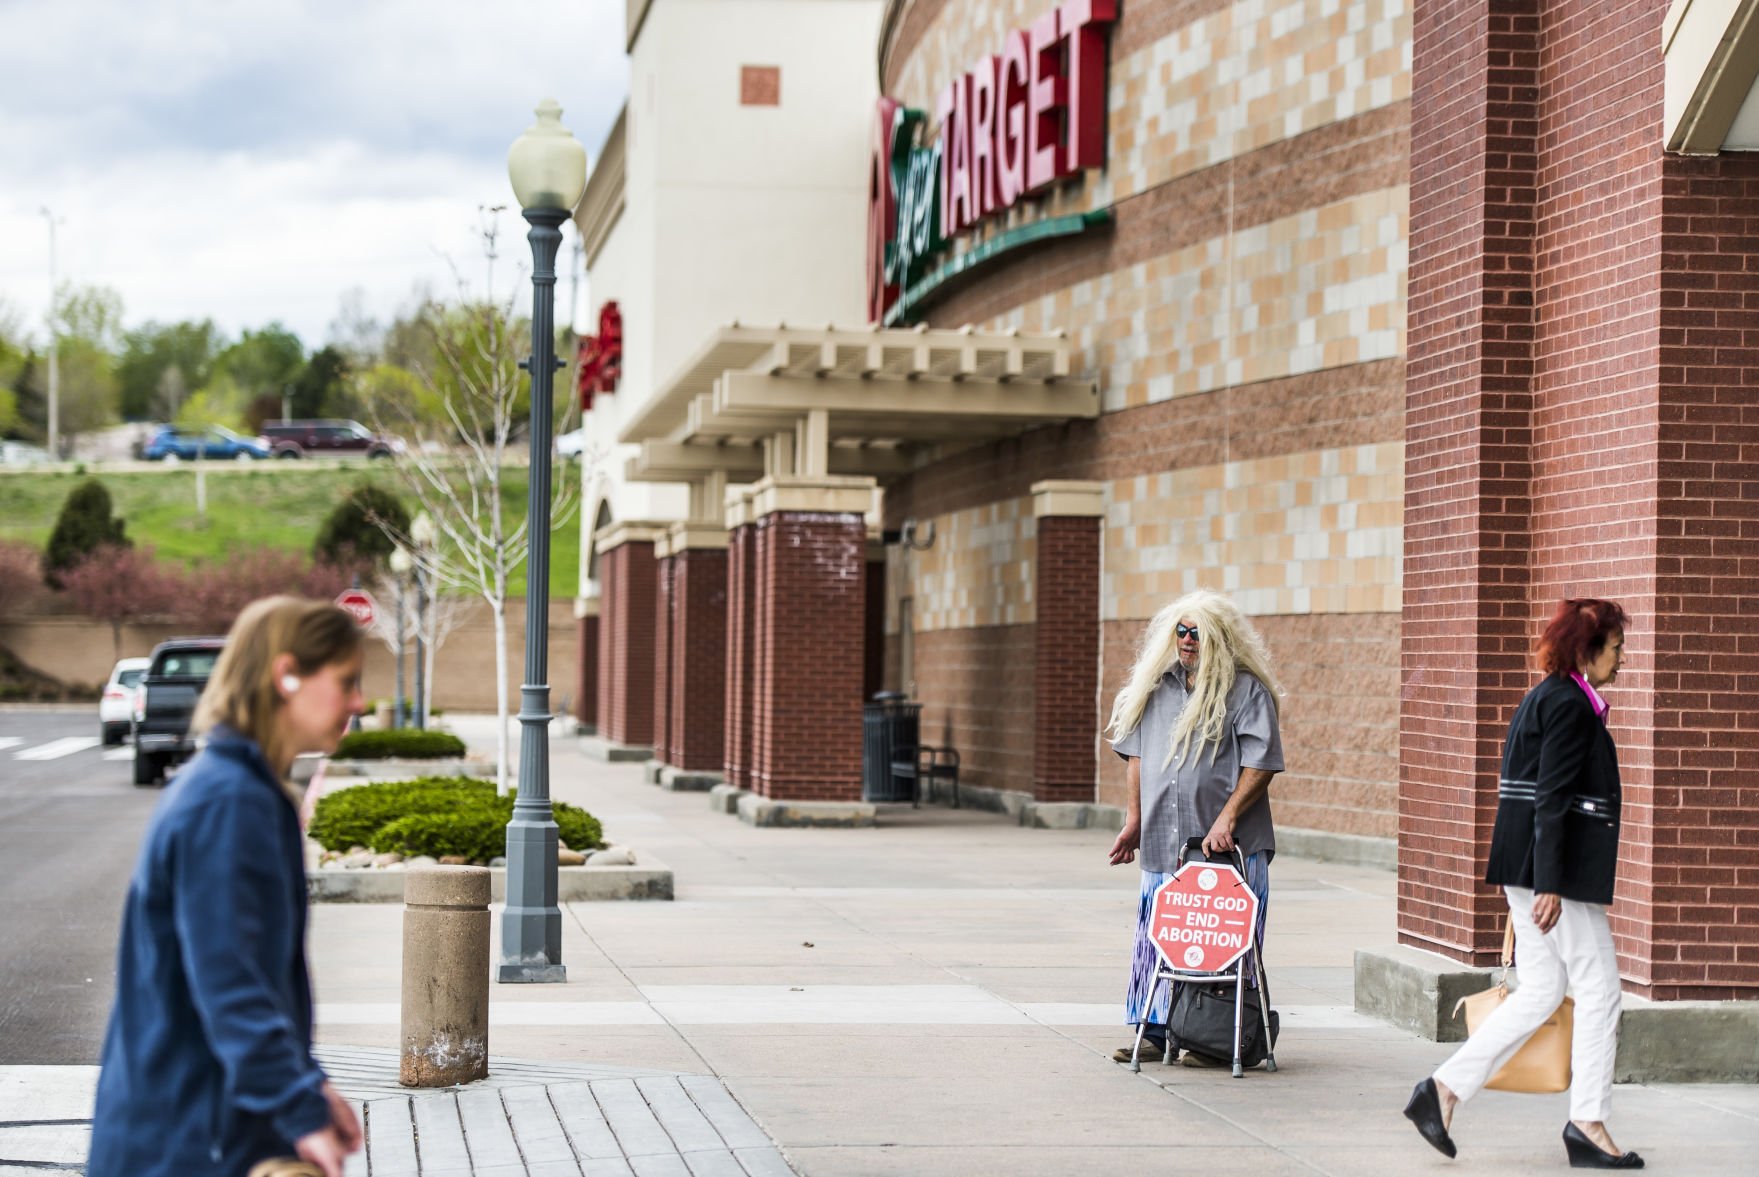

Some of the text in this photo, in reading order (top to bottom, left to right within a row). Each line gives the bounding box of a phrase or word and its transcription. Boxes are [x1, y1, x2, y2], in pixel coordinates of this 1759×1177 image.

[936, 0, 1100, 240] TARGET
[1164, 891, 1248, 912] TRUST GOD
[1185, 911, 1220, 928] END
[1157, 926, 1243, 948] ABORTION
